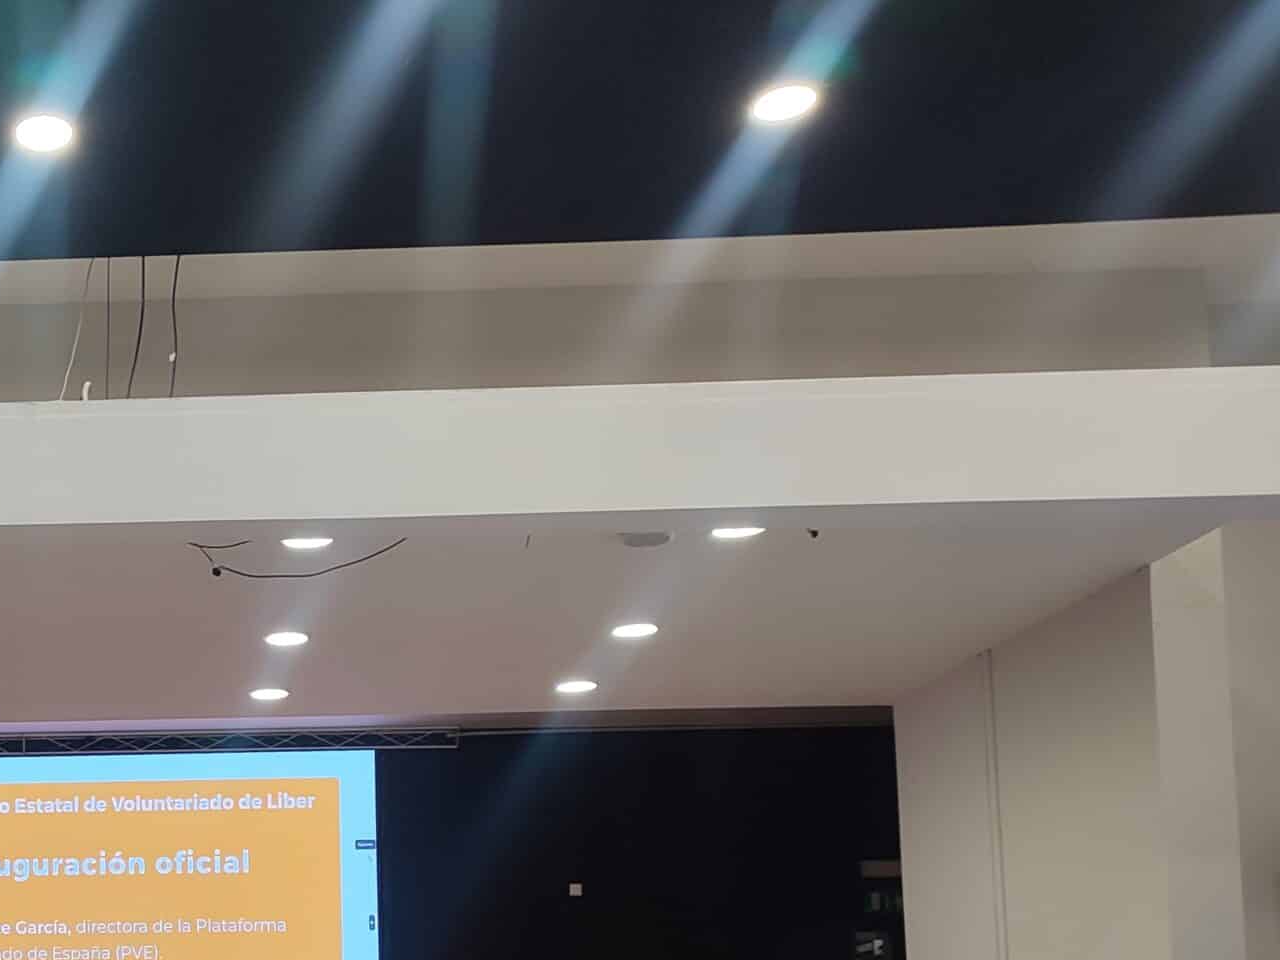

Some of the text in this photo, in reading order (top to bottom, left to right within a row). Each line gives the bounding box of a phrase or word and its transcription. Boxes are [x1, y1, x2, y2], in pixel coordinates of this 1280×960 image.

[15, 796, 79, 814] Estatal
[84, 796, 106, 813] de
[112, 793, 234, 812] Voluntariado
[238, 793, 262, 810] de
[267, 792, 316, 809] Liber
[155, 848, 250, 875] oficial
[15, 919, 71, 937] García,
[76, 919, 148, 934] directora
[152, 919, 173, 933] de
[177, 918, 191, 933] la
[196, 917, 287, 933] Plataforma
[27, 947, 48, 960] de
